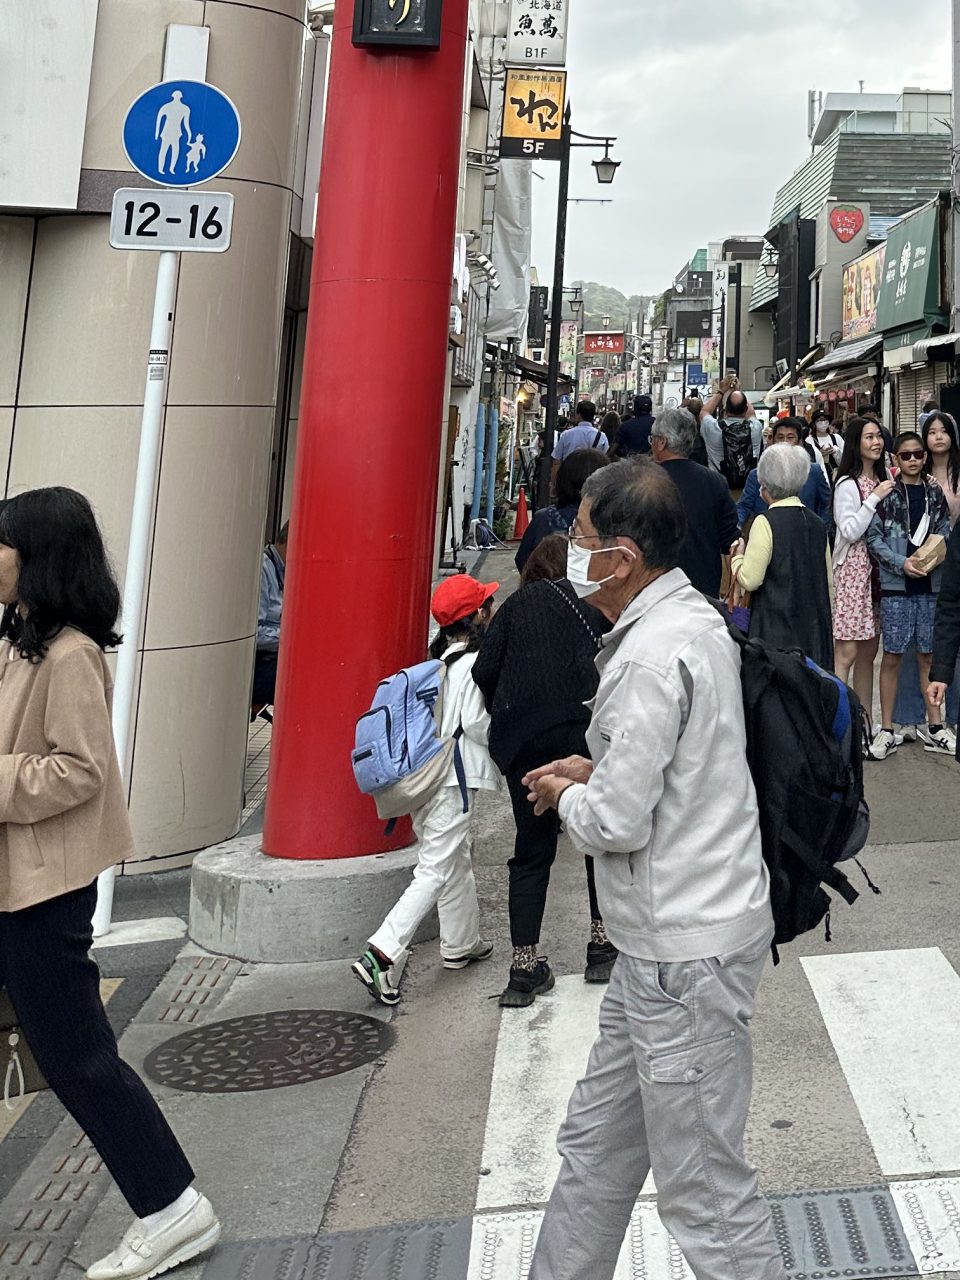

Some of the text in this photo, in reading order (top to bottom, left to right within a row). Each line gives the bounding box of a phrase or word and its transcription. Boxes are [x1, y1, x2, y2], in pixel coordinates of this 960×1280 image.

[529, 0, 563, 11] 北海道
[513, 14, 559, 38] 魚萬
[525, 47, 548, 58] B1F
[510, 90, 559, 133] わん
[522, 139, 545, 154] 5F
[124, 201, 223, 240] 12-16
